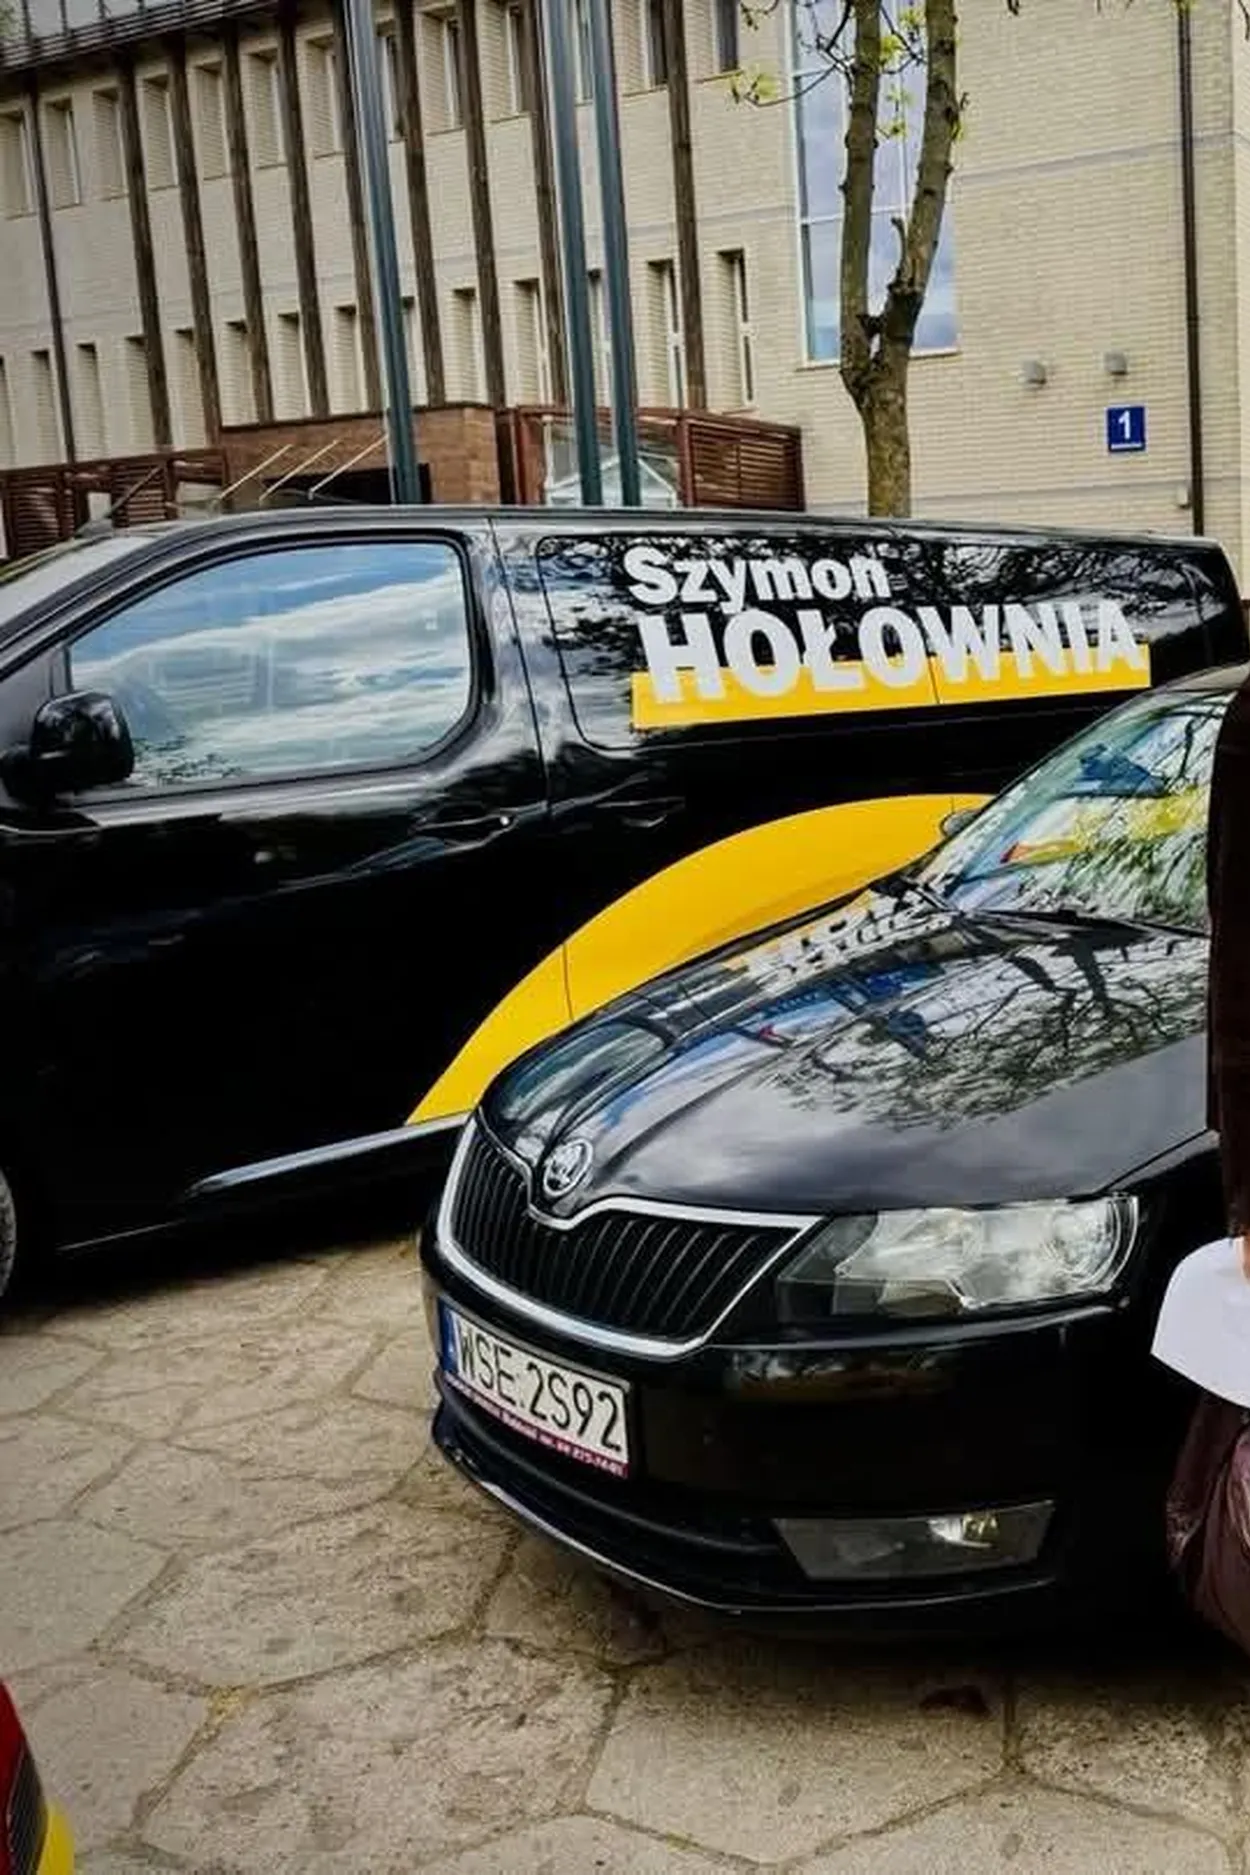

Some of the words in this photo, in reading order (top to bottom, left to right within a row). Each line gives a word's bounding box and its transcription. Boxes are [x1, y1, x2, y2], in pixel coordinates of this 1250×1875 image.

[1118, 410, 1131, 439] 1
[622, 545, 892, 614] Szymon
[638, 600, 1146, 704] HOŁOWNIA
[527, 1361, 622, 1453] 2S92
